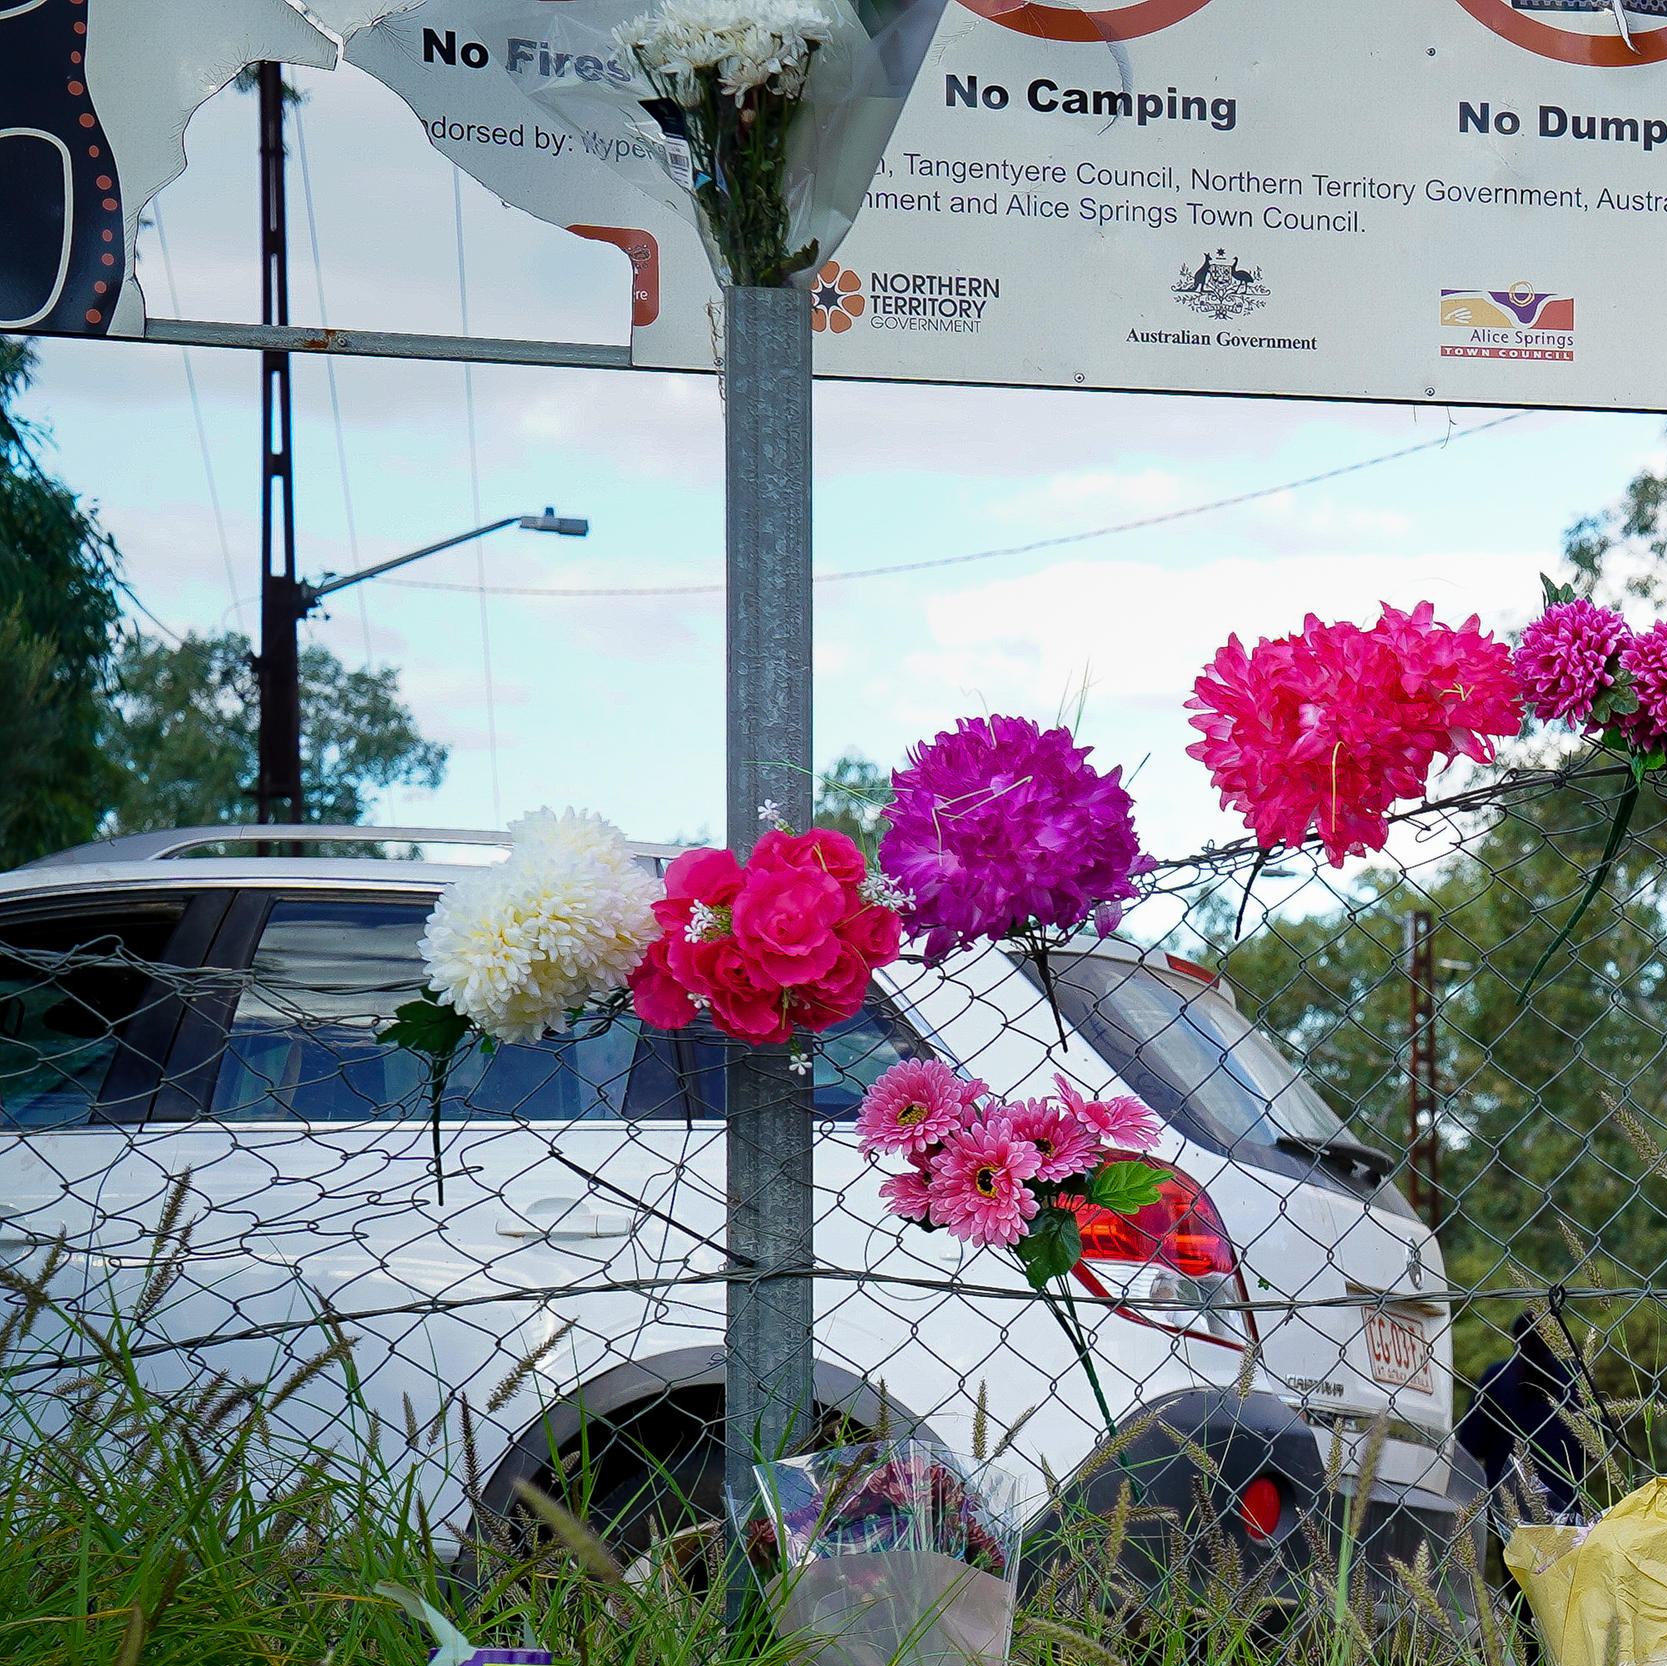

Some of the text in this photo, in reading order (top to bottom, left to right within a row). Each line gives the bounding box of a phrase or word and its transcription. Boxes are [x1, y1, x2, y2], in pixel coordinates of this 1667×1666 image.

[423, 28, 632, 83] No Fires
[945, 74, 1237, 131] No Camping
[1459, 101, 1521, 136] No
[535, 125, 573, 157] by:
[903, 153, 1067, 186] Tangentyere
[1076, 162, 1181, 192] Council,
[1191, 168, 1303, 195] Northern
[1312, 174, 1416, 206] Territory
[1425, 179, 1589, 212] Government,
[950, 193, 998, 216] and
[1006, 193, 1070, 219] Alice
[1079, 197, 1178, 228] Springs
[1186, 202, 1253, 227] Town
[1263, 206, 1366, 233] Council.
[871, 273, 1000, 299] NORTHERN
[870, 294, 987, 319] TERRITORY
[870, 316, 982, 334] GOVERNMENT
[1126, 328, 1318, 350] Australian Government
[1470, 329, 1574, 349] Alice Springs
[1444, 347, 1570, 360] TOWN COUNCIL
